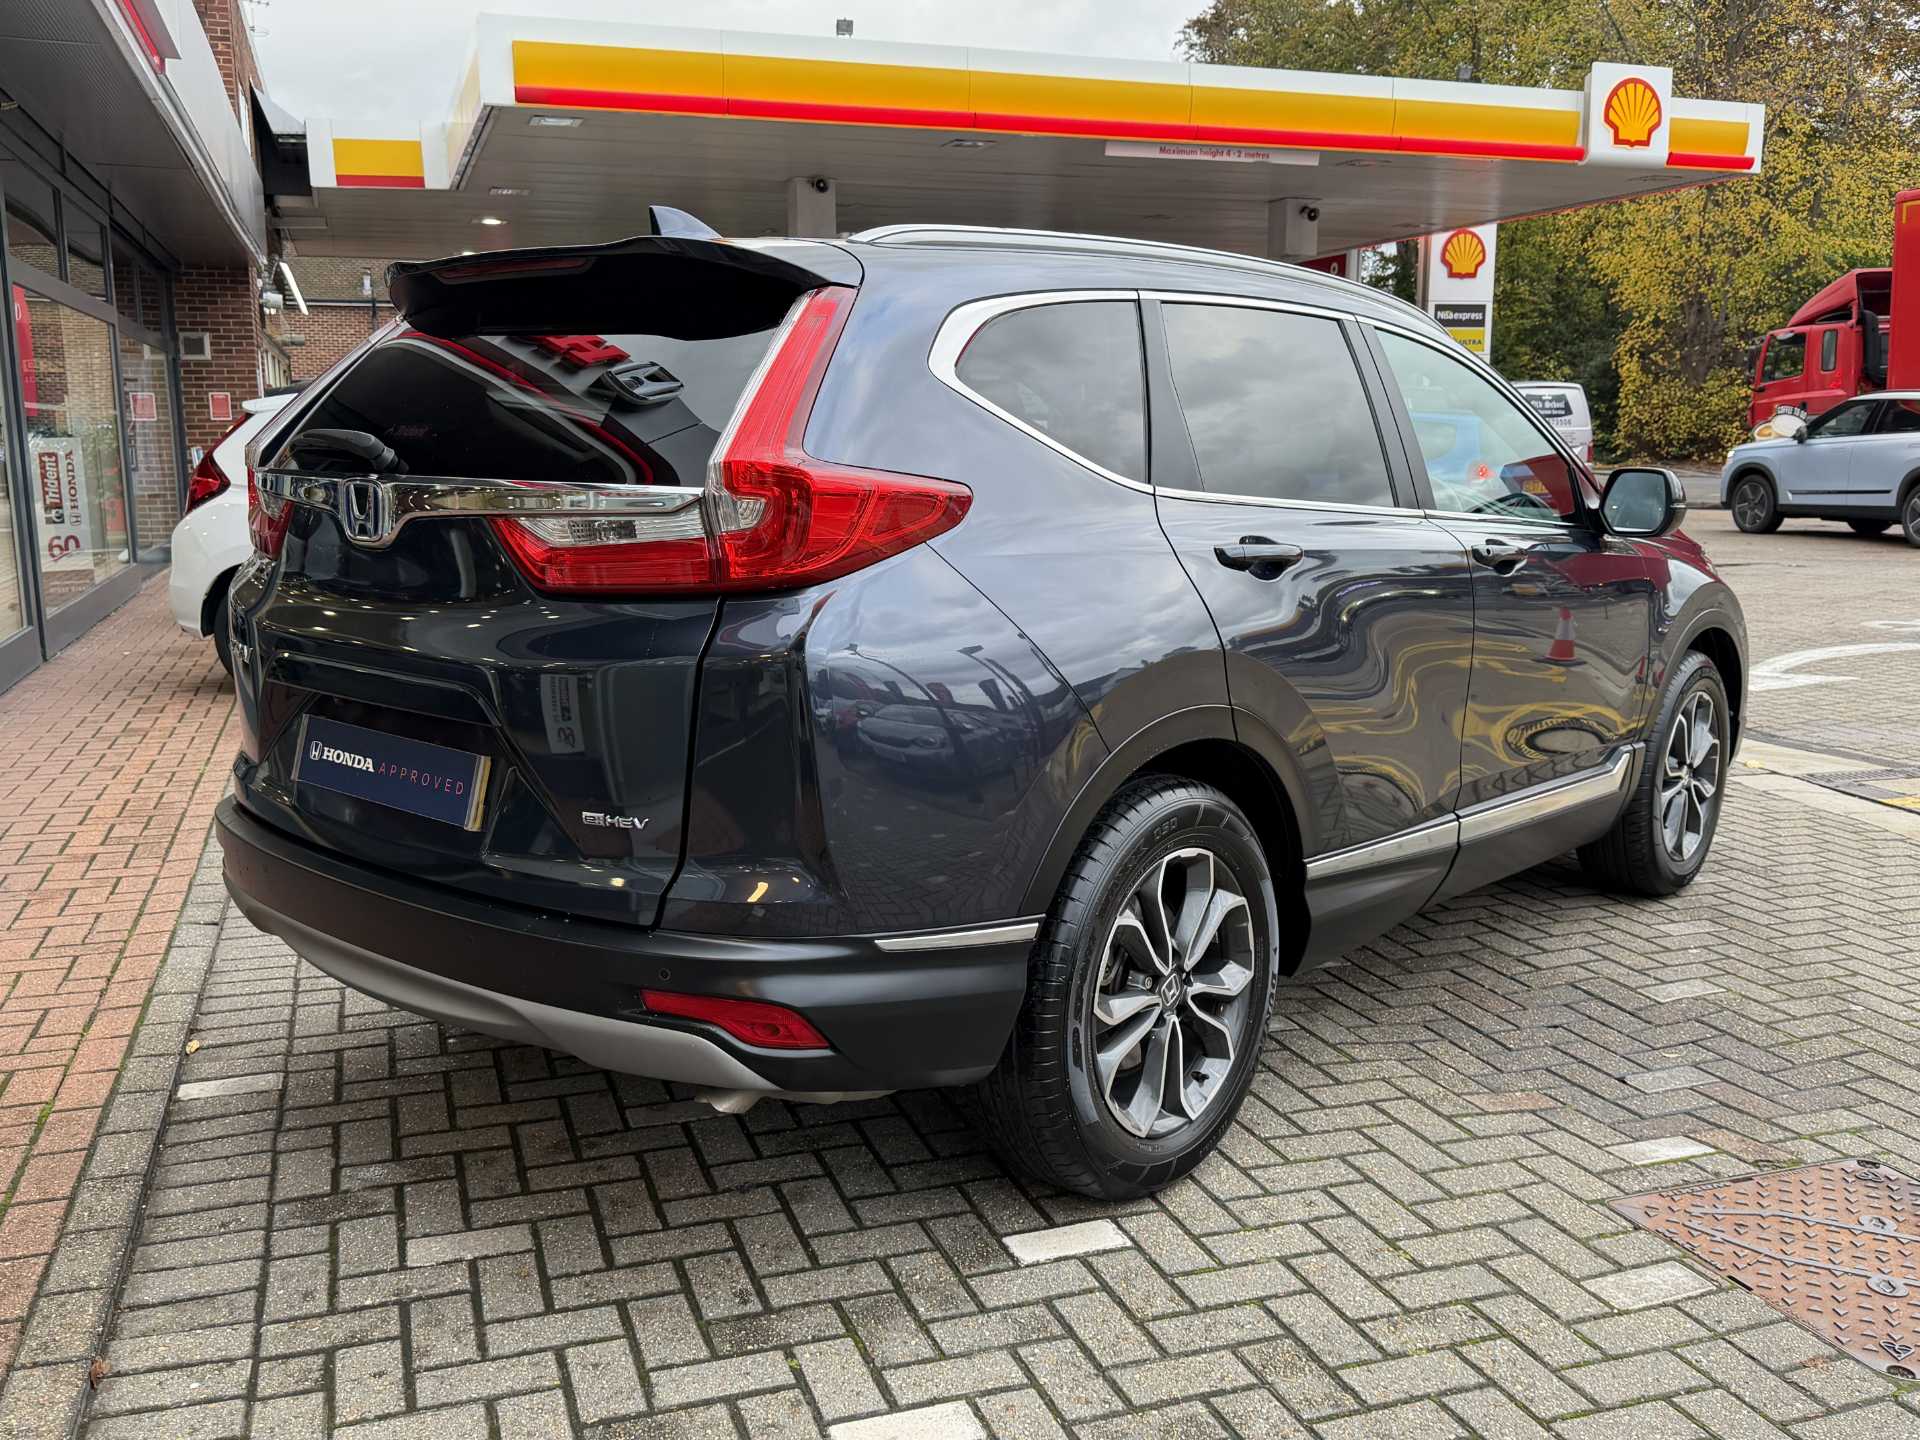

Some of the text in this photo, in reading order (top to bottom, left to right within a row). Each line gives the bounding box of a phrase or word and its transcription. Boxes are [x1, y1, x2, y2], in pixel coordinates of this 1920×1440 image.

[1159, 146, 1198, 156] Maximum
[1199, 147, 1225, 159] height
[42, 454, 60, 505] Trident
[65, 450, 79, 510] HONDA
[321, 746, 465, 796] HONDA APPROVED
